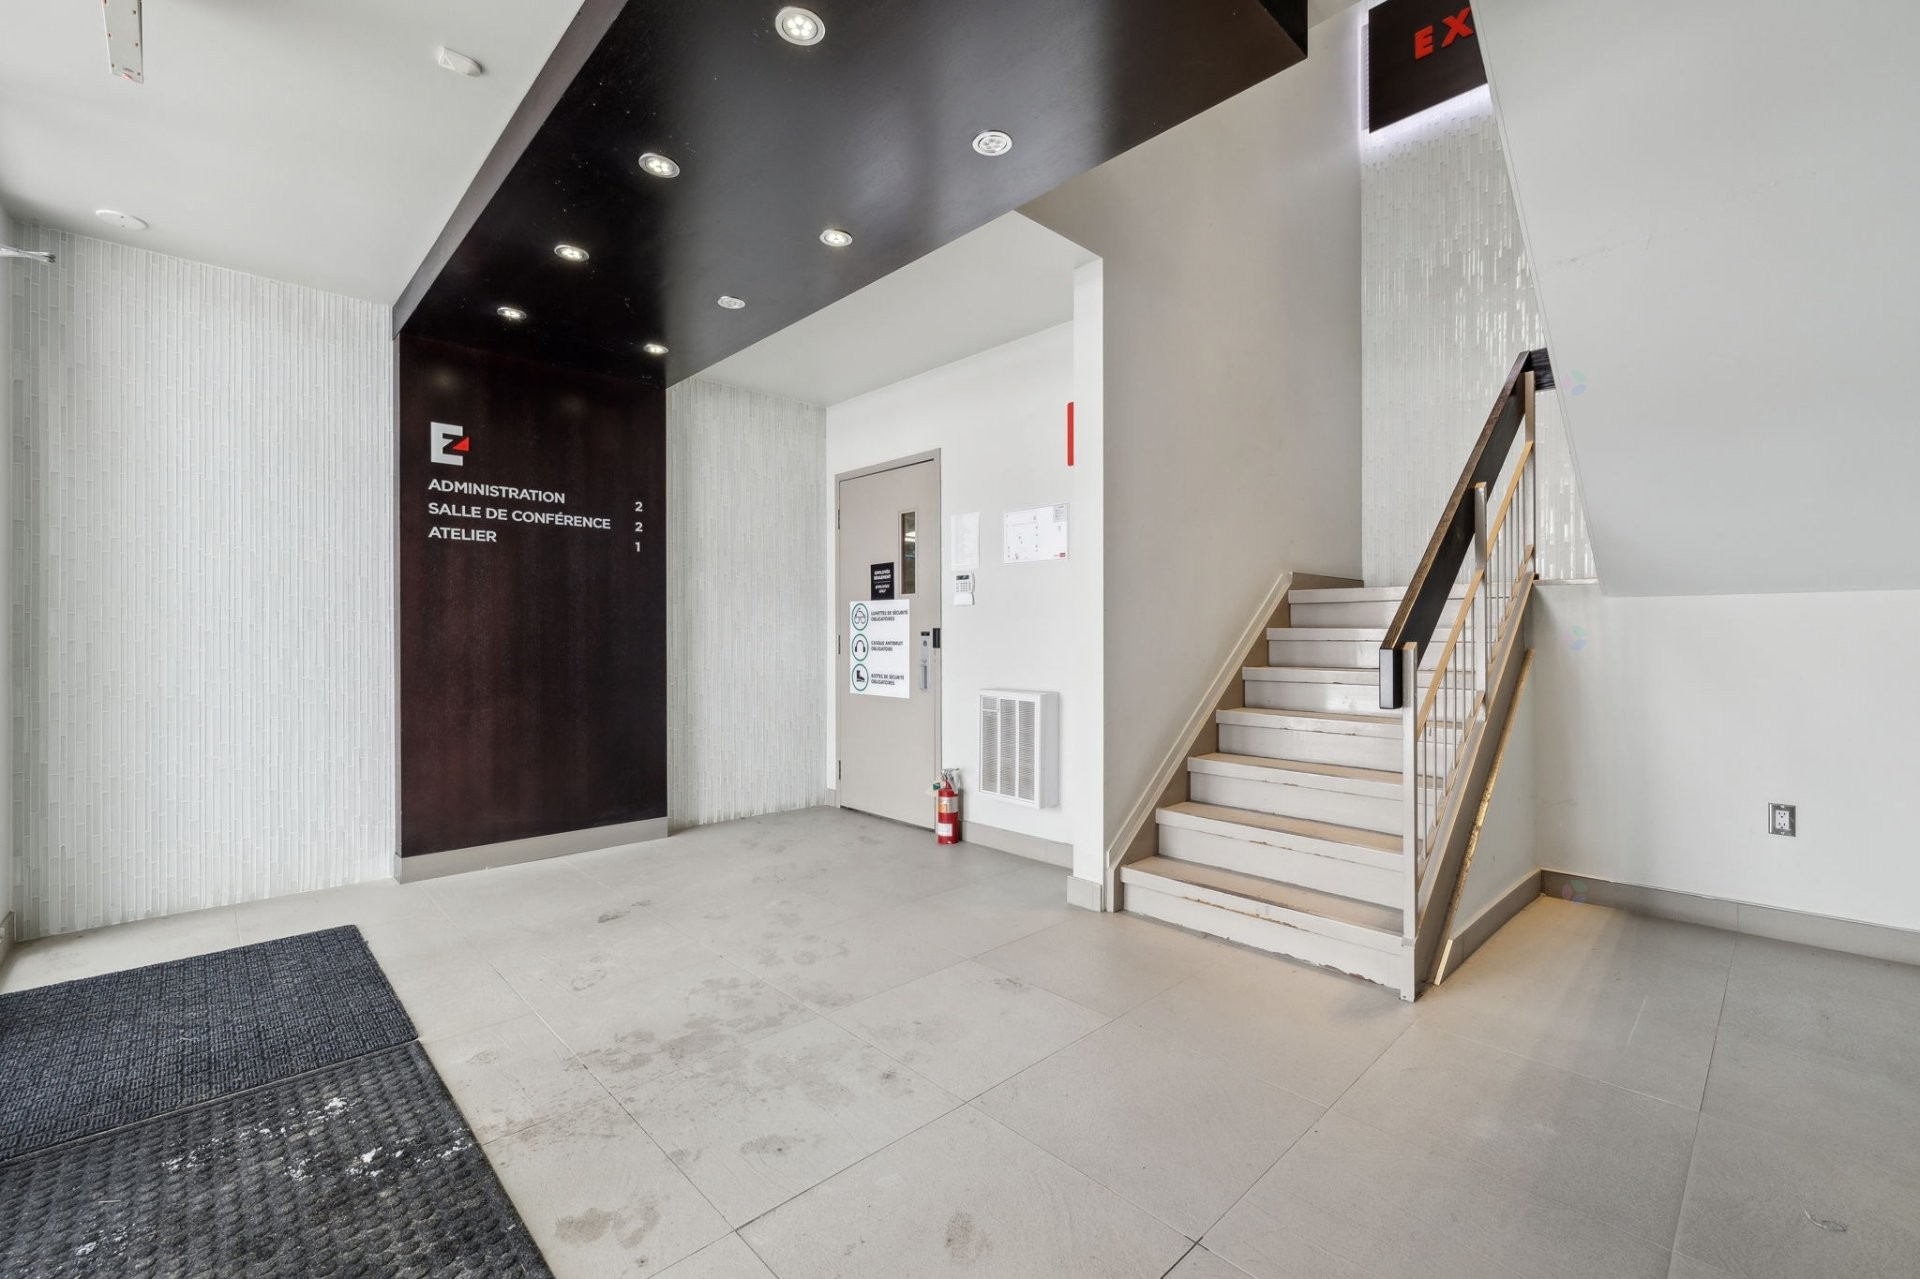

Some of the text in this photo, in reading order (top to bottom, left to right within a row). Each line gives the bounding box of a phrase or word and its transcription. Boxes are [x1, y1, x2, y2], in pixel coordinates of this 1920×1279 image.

[428, 478, 643, 512] ADMINISTRATION 2
[428, 502, 643, 533] SALLE DE CONFÉRENCE 2
[428, 526, 641, 553] ATELIER 1
